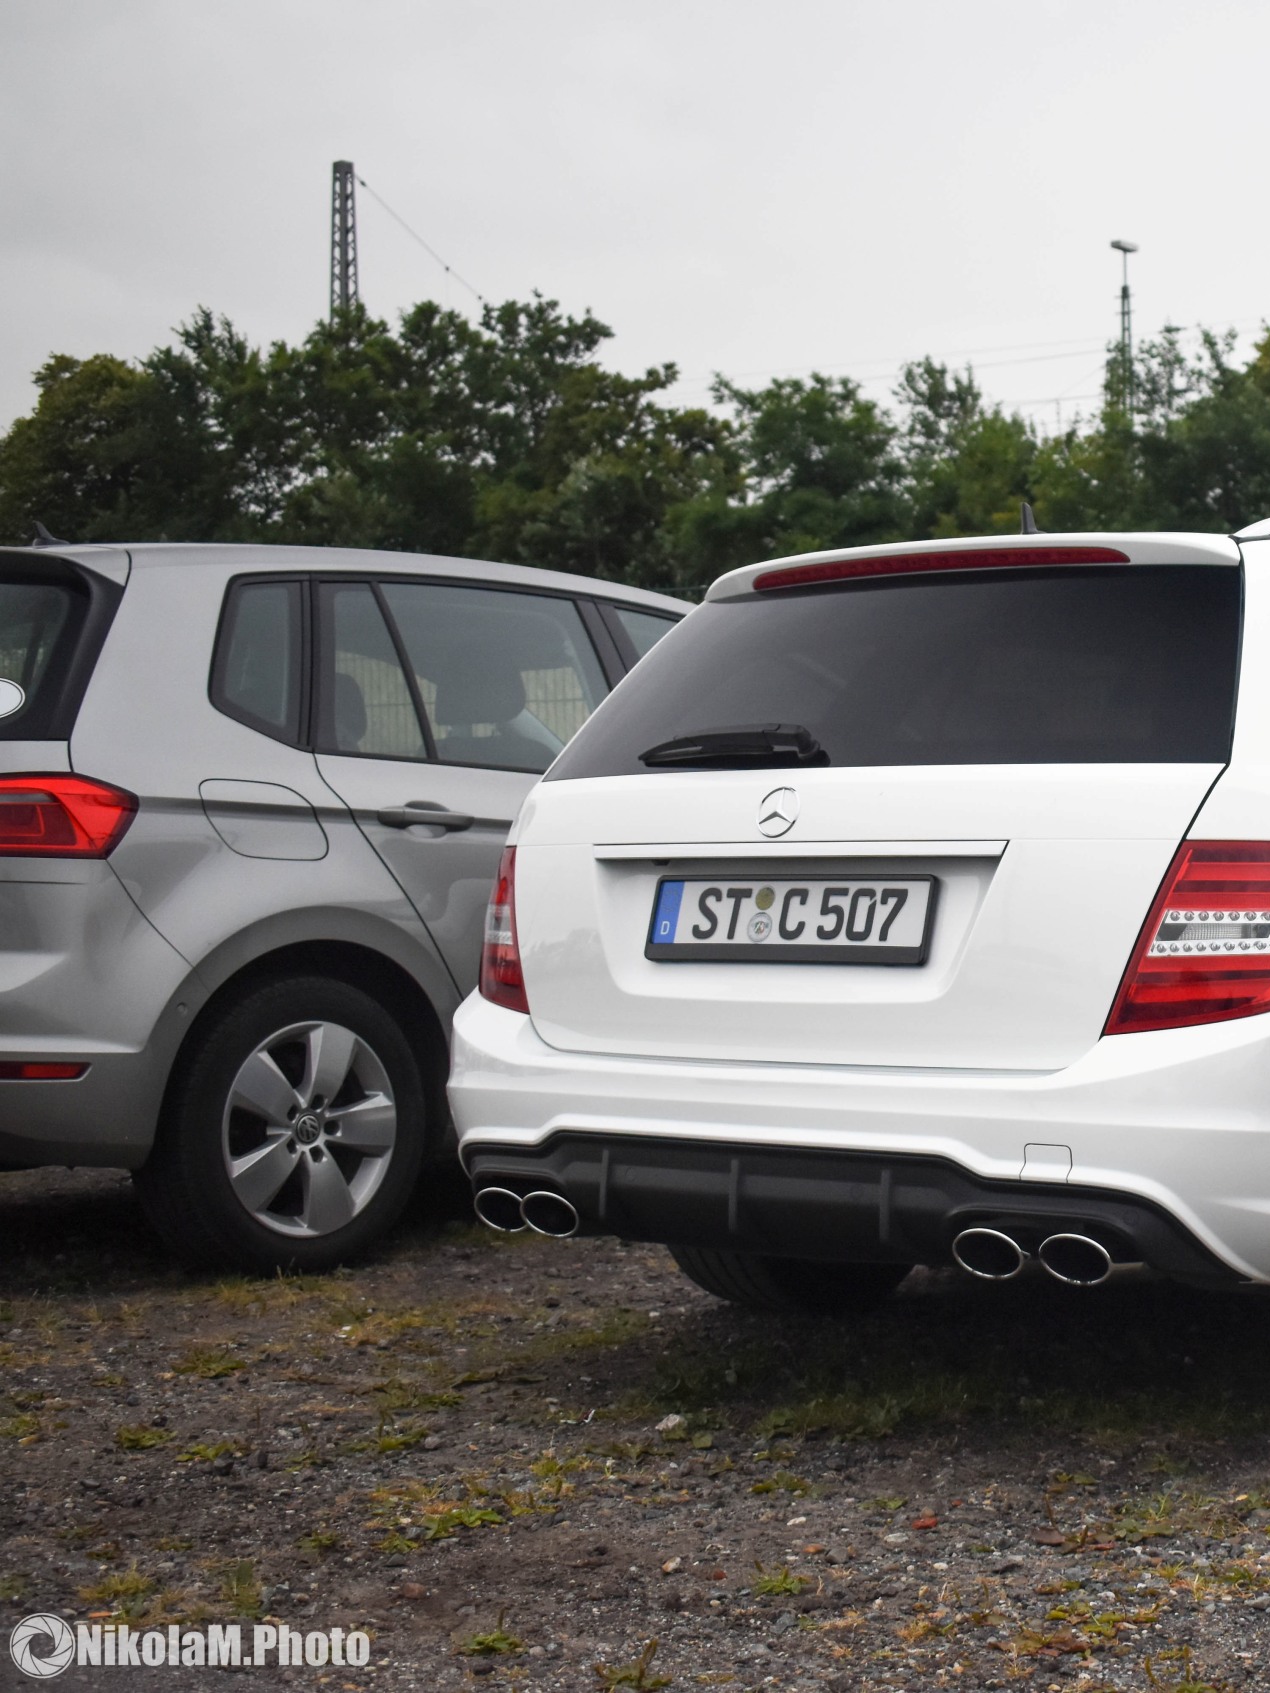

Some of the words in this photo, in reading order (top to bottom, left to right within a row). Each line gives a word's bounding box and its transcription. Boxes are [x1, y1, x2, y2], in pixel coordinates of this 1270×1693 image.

[659, 920, 671, 936] D
[691, 887, 753, 940] ST
[778, 887, 810, 941] C
[816, 887, 909, 942] 507
